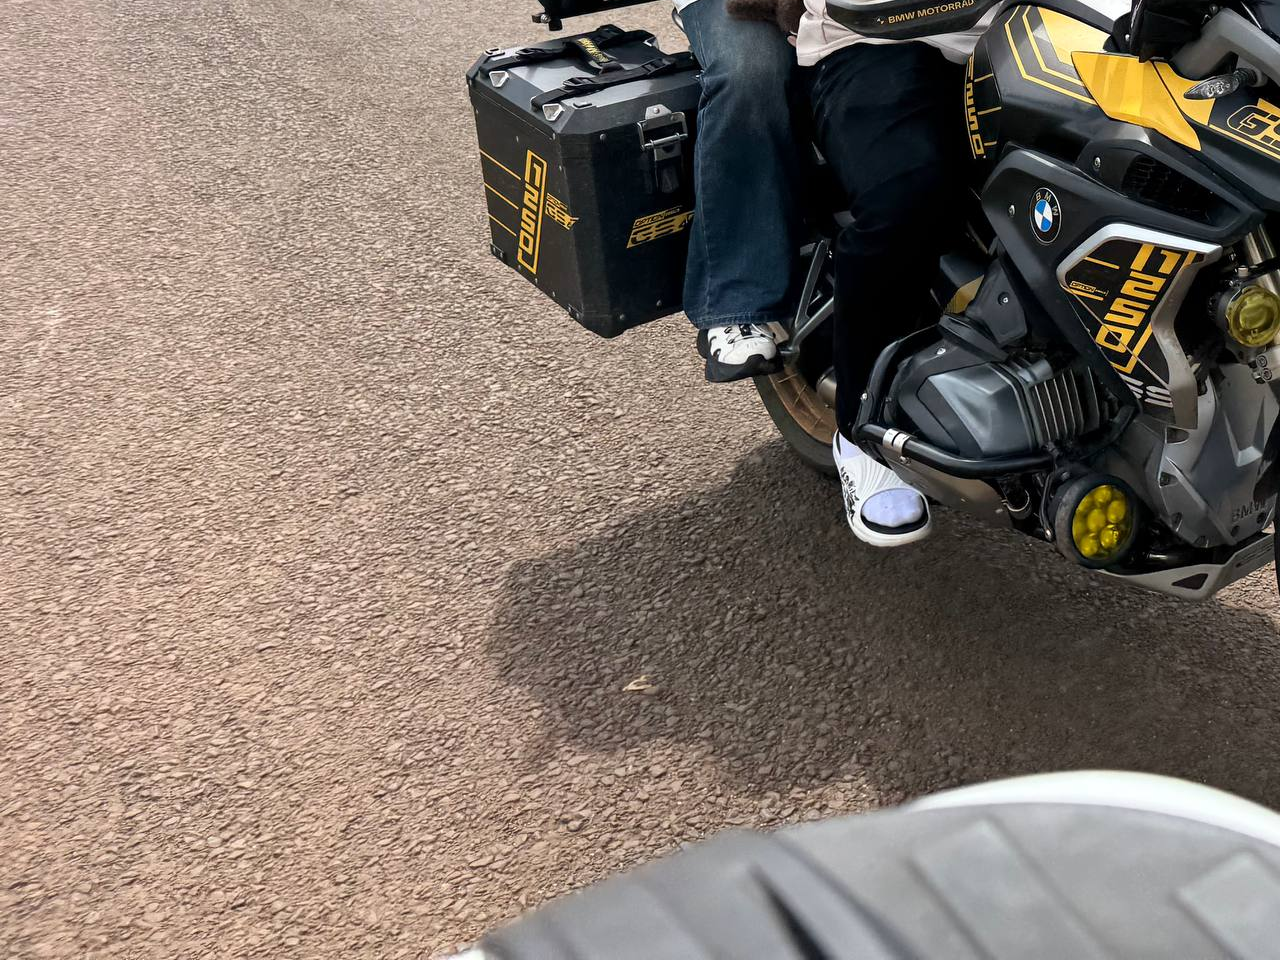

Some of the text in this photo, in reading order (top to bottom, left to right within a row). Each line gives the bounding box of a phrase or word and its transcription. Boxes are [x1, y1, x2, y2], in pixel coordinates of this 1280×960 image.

[888, 11, 916, 24] BMW
[519, 162, 542, 256] 1250
[1035, 191, 1059, 216] BMW
[1095, 248, 1182, 354] 1250
